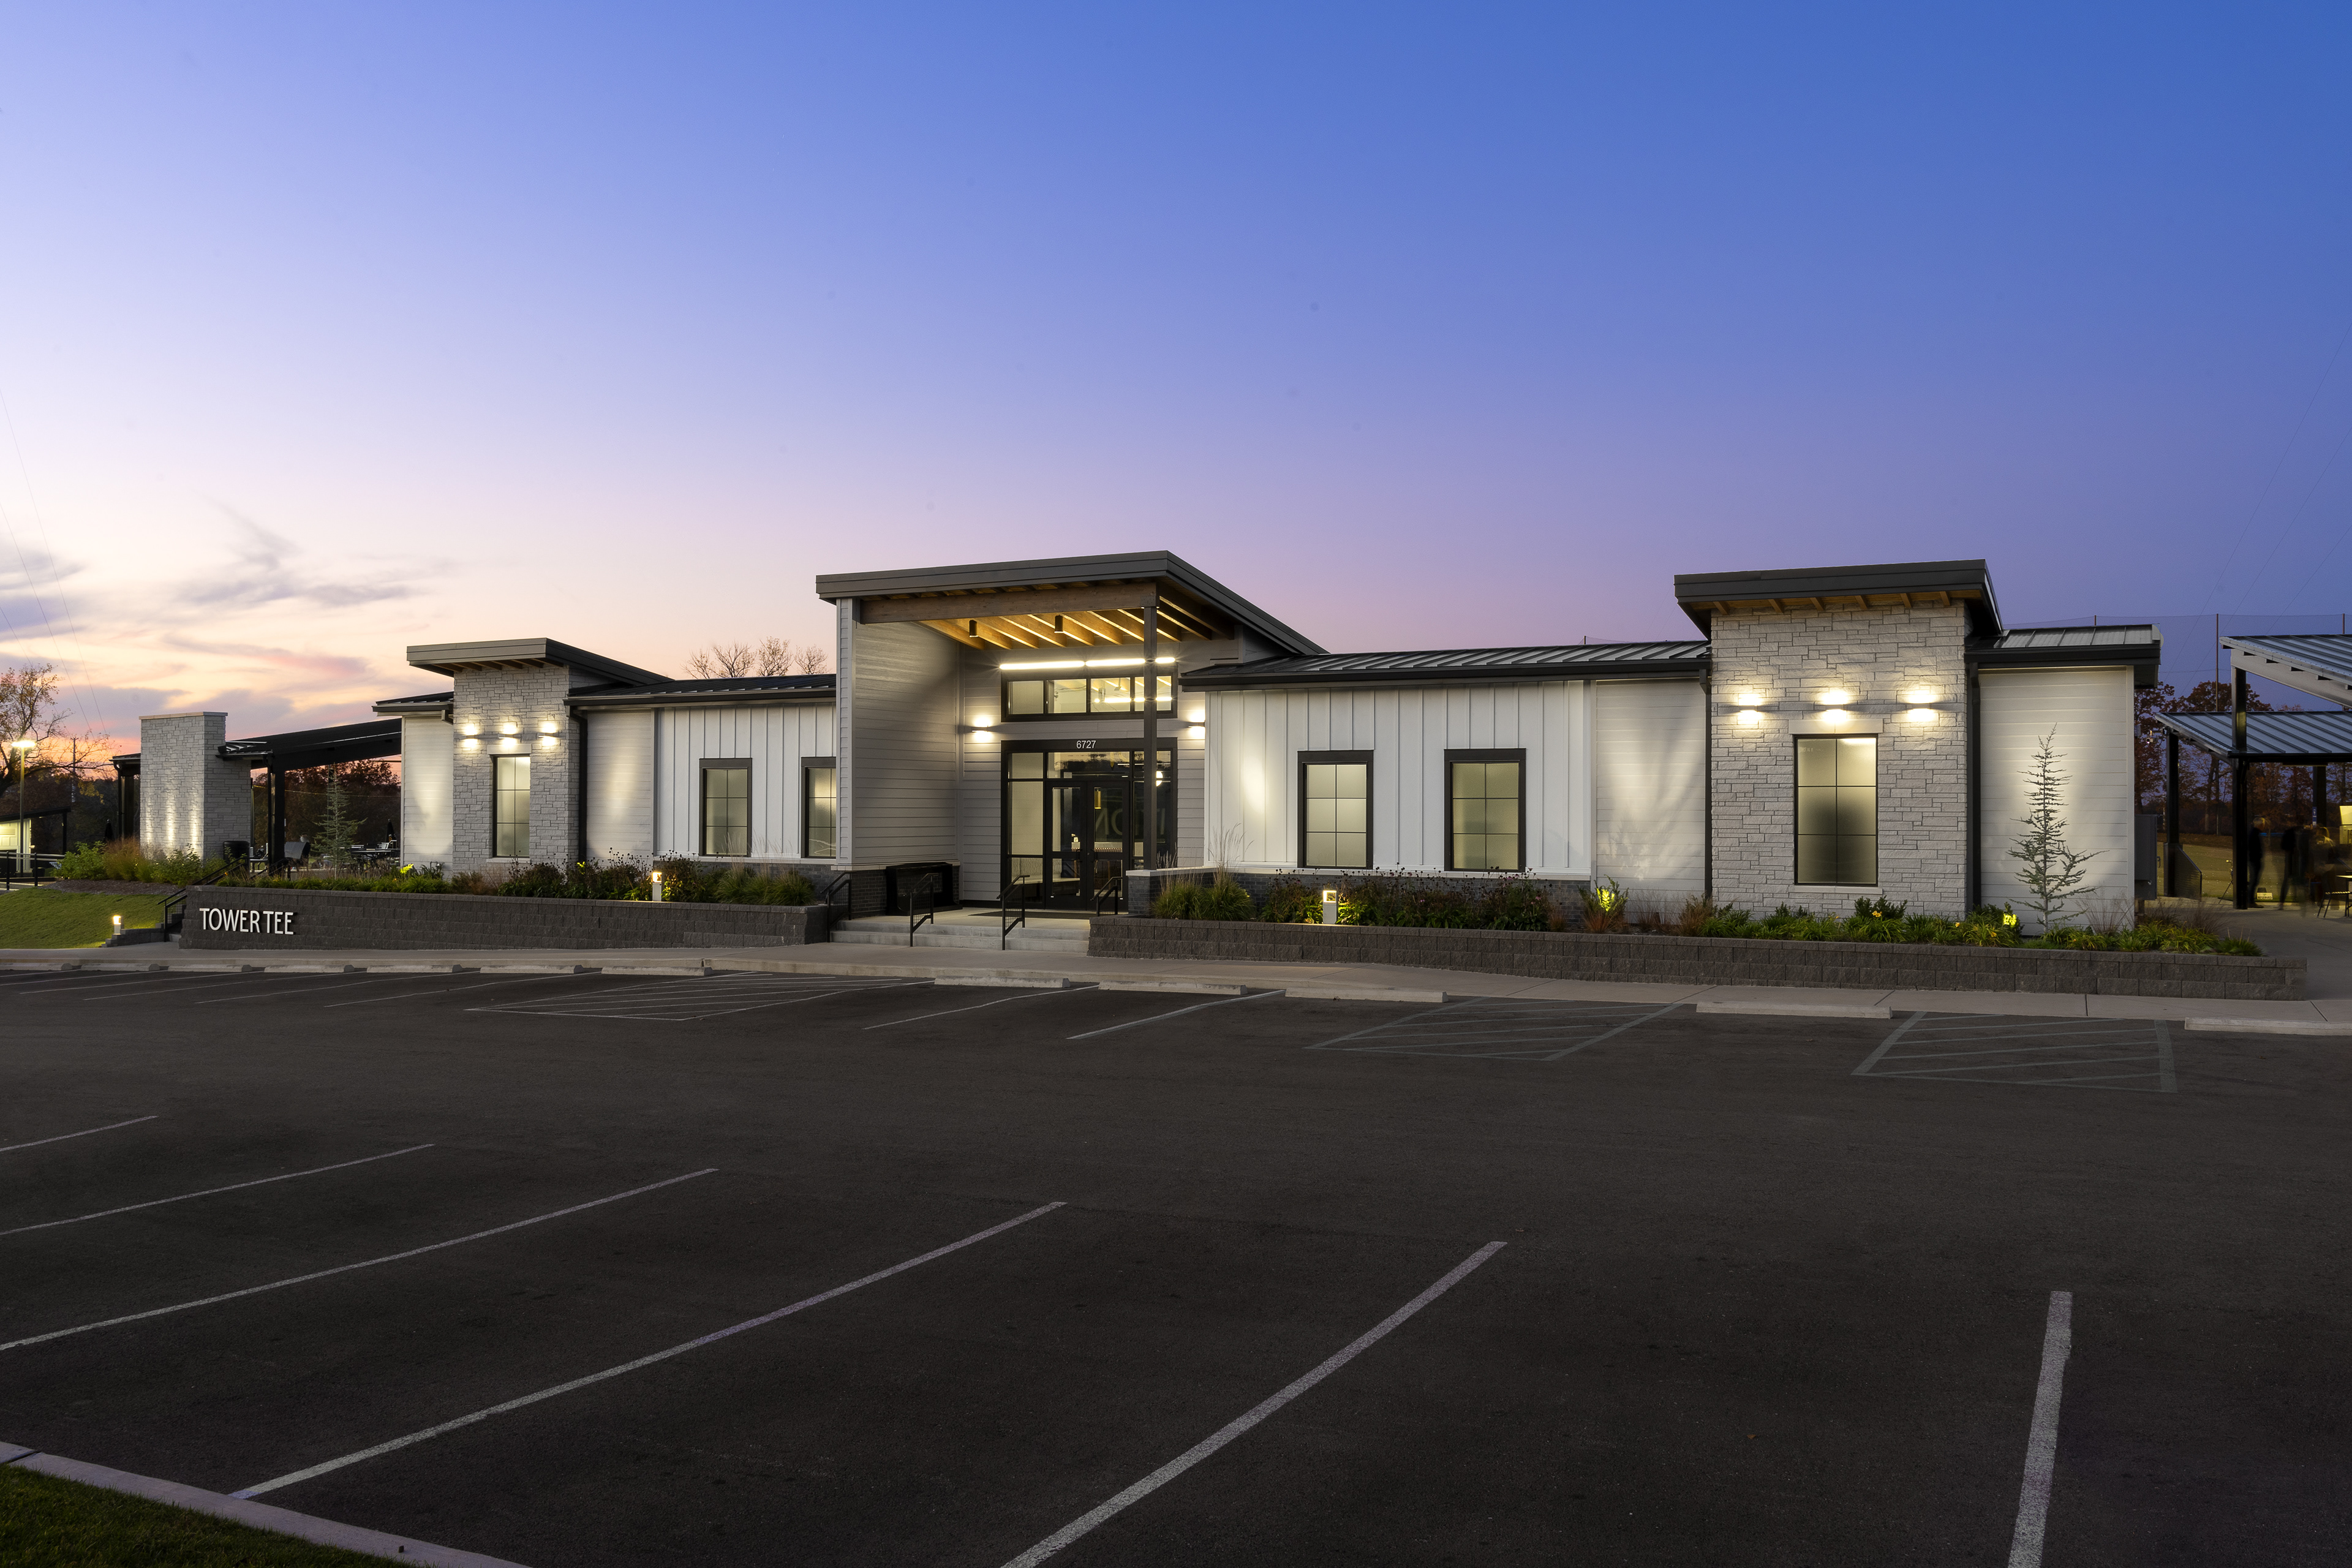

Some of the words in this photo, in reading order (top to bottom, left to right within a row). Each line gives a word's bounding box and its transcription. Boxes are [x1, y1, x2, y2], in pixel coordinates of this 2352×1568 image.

[1076, 740, 1096, 749] 6727
[199, 908, 260, 933] TOWER
[263, 910, 294, 935] TEE
